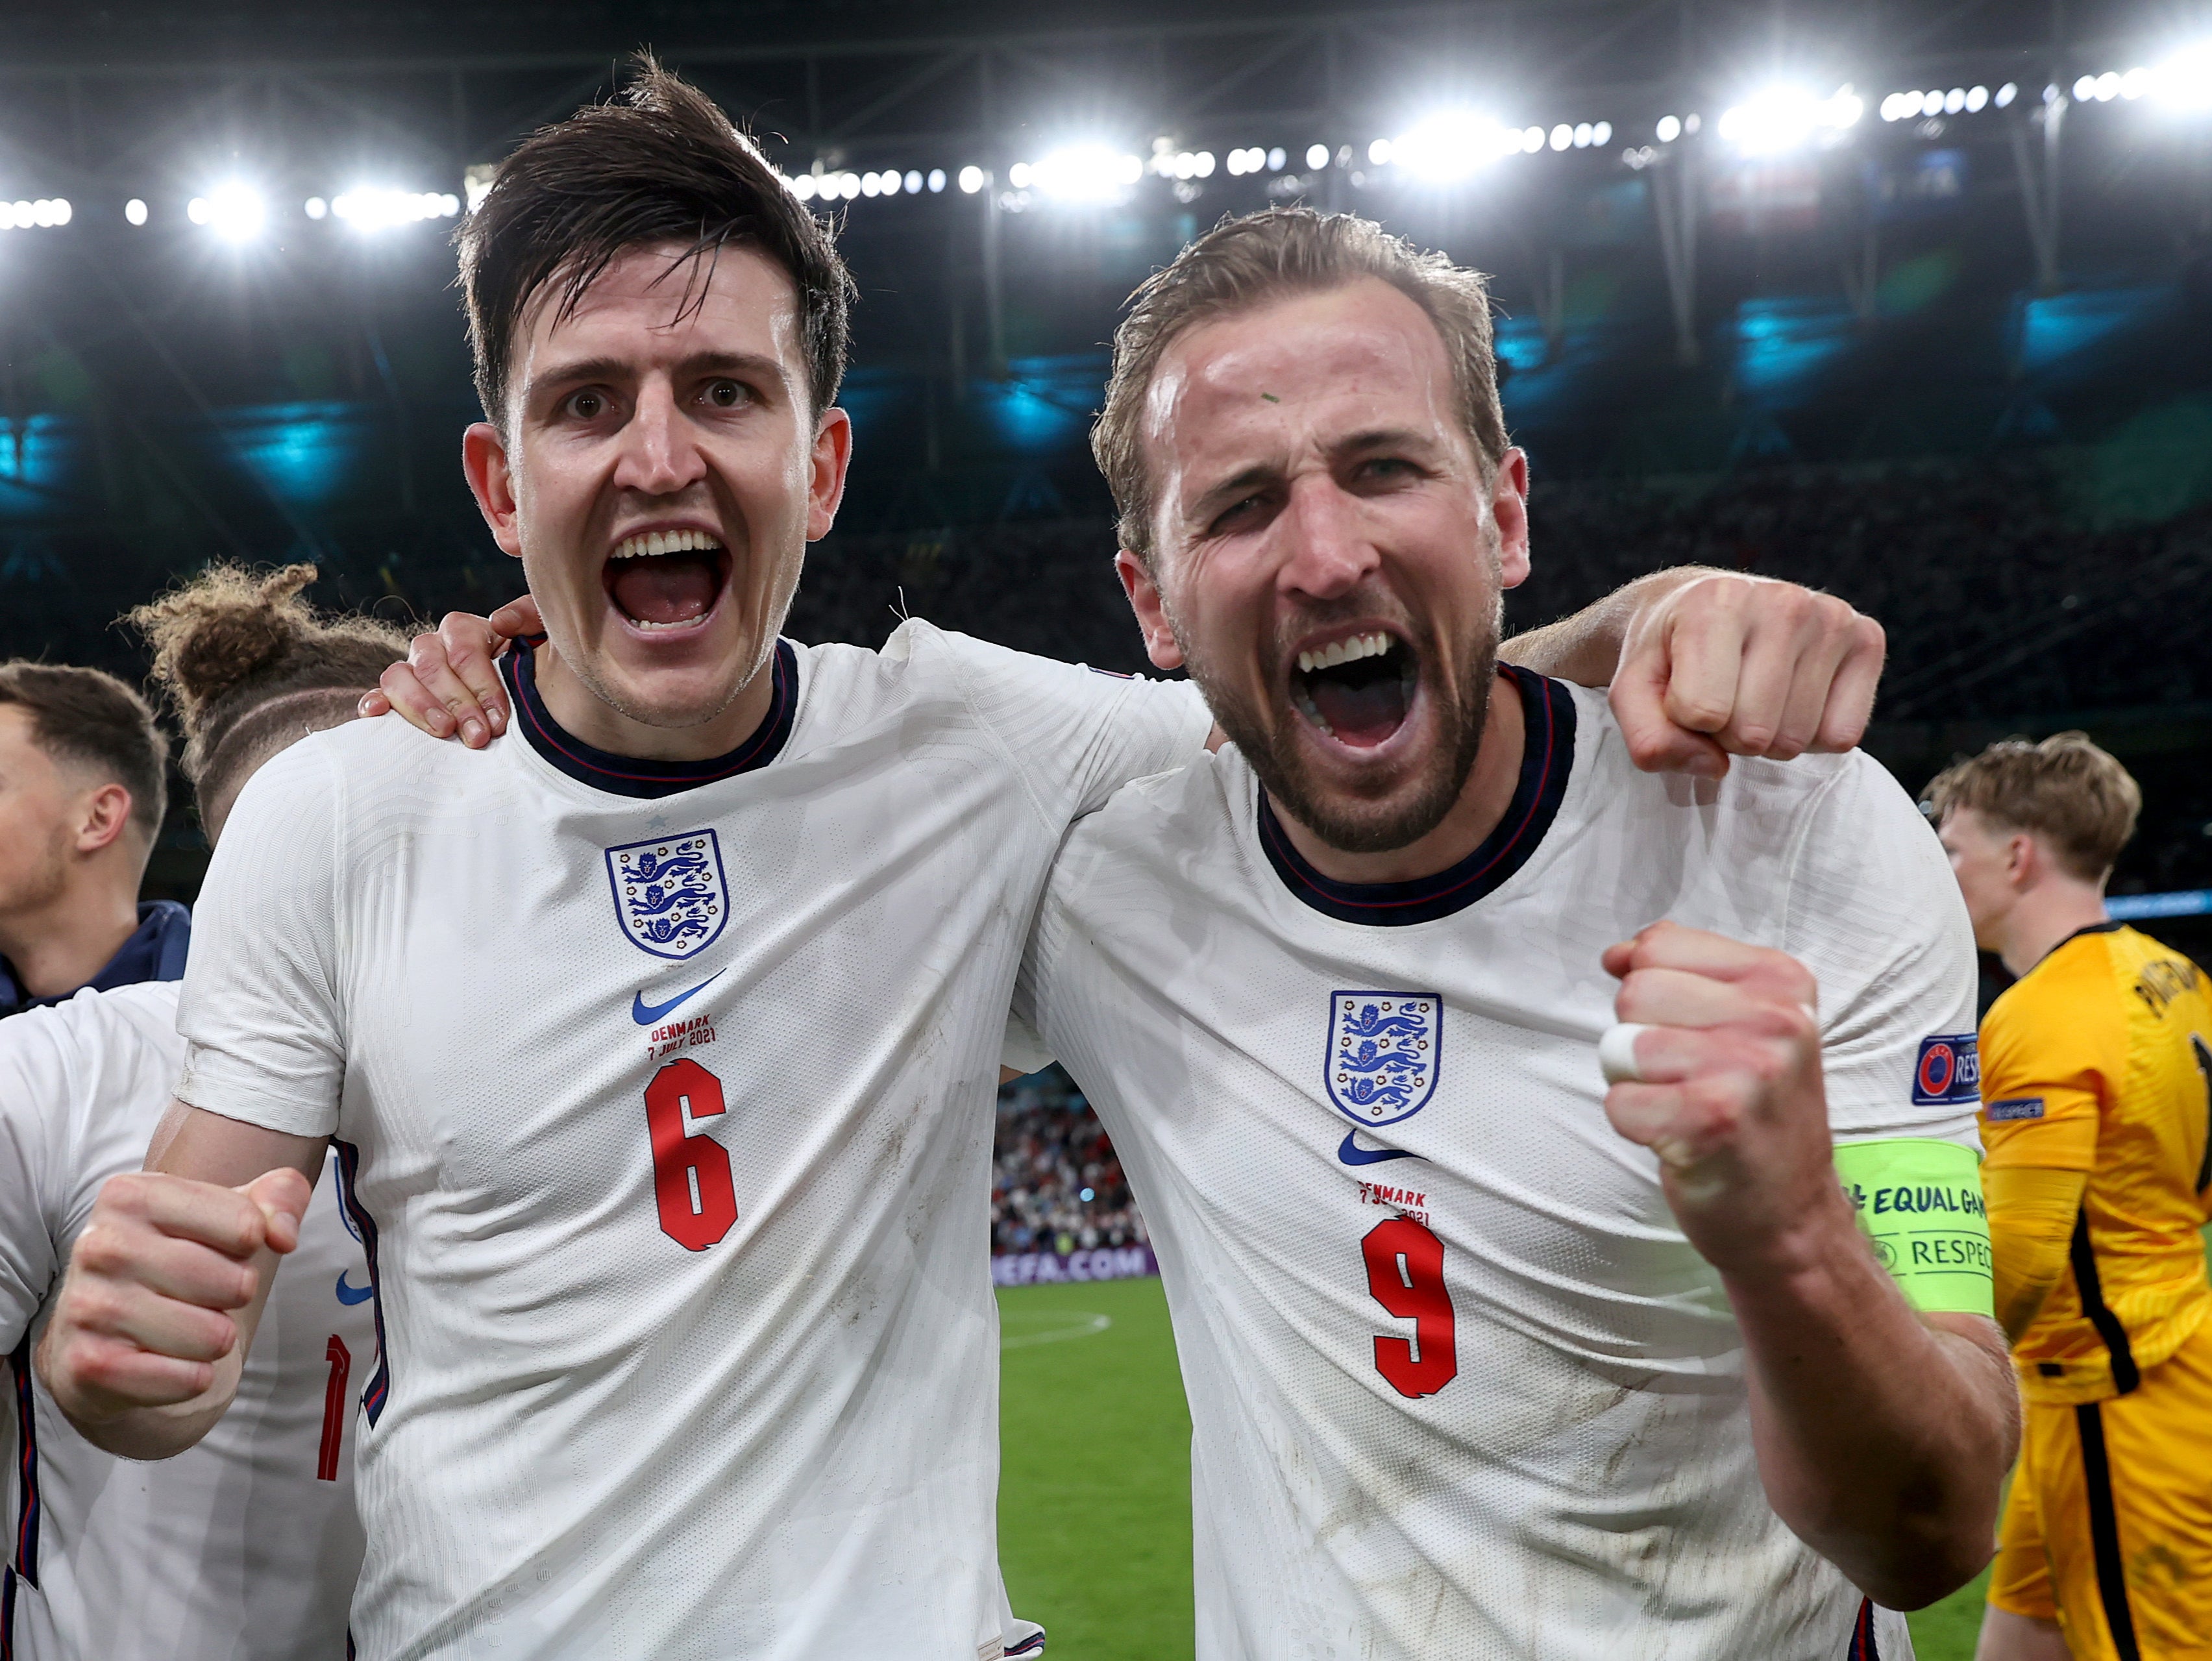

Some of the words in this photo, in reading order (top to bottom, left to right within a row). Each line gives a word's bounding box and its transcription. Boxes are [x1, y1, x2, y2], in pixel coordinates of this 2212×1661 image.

[651, 1013, 710, 1042] DENMARK
[648, 1046, 655, 1061] 7
[658, 1037, 685, 1057] JULY
[689, 1027, 717, 1046] 2021
[644, 1057, 739, 1252] 6
[1360, 1189, 1367, 1204] 7
[1911, 1239, 1992, 1270] RESPEC
[1360, 1214, 1458, 1399] 9
